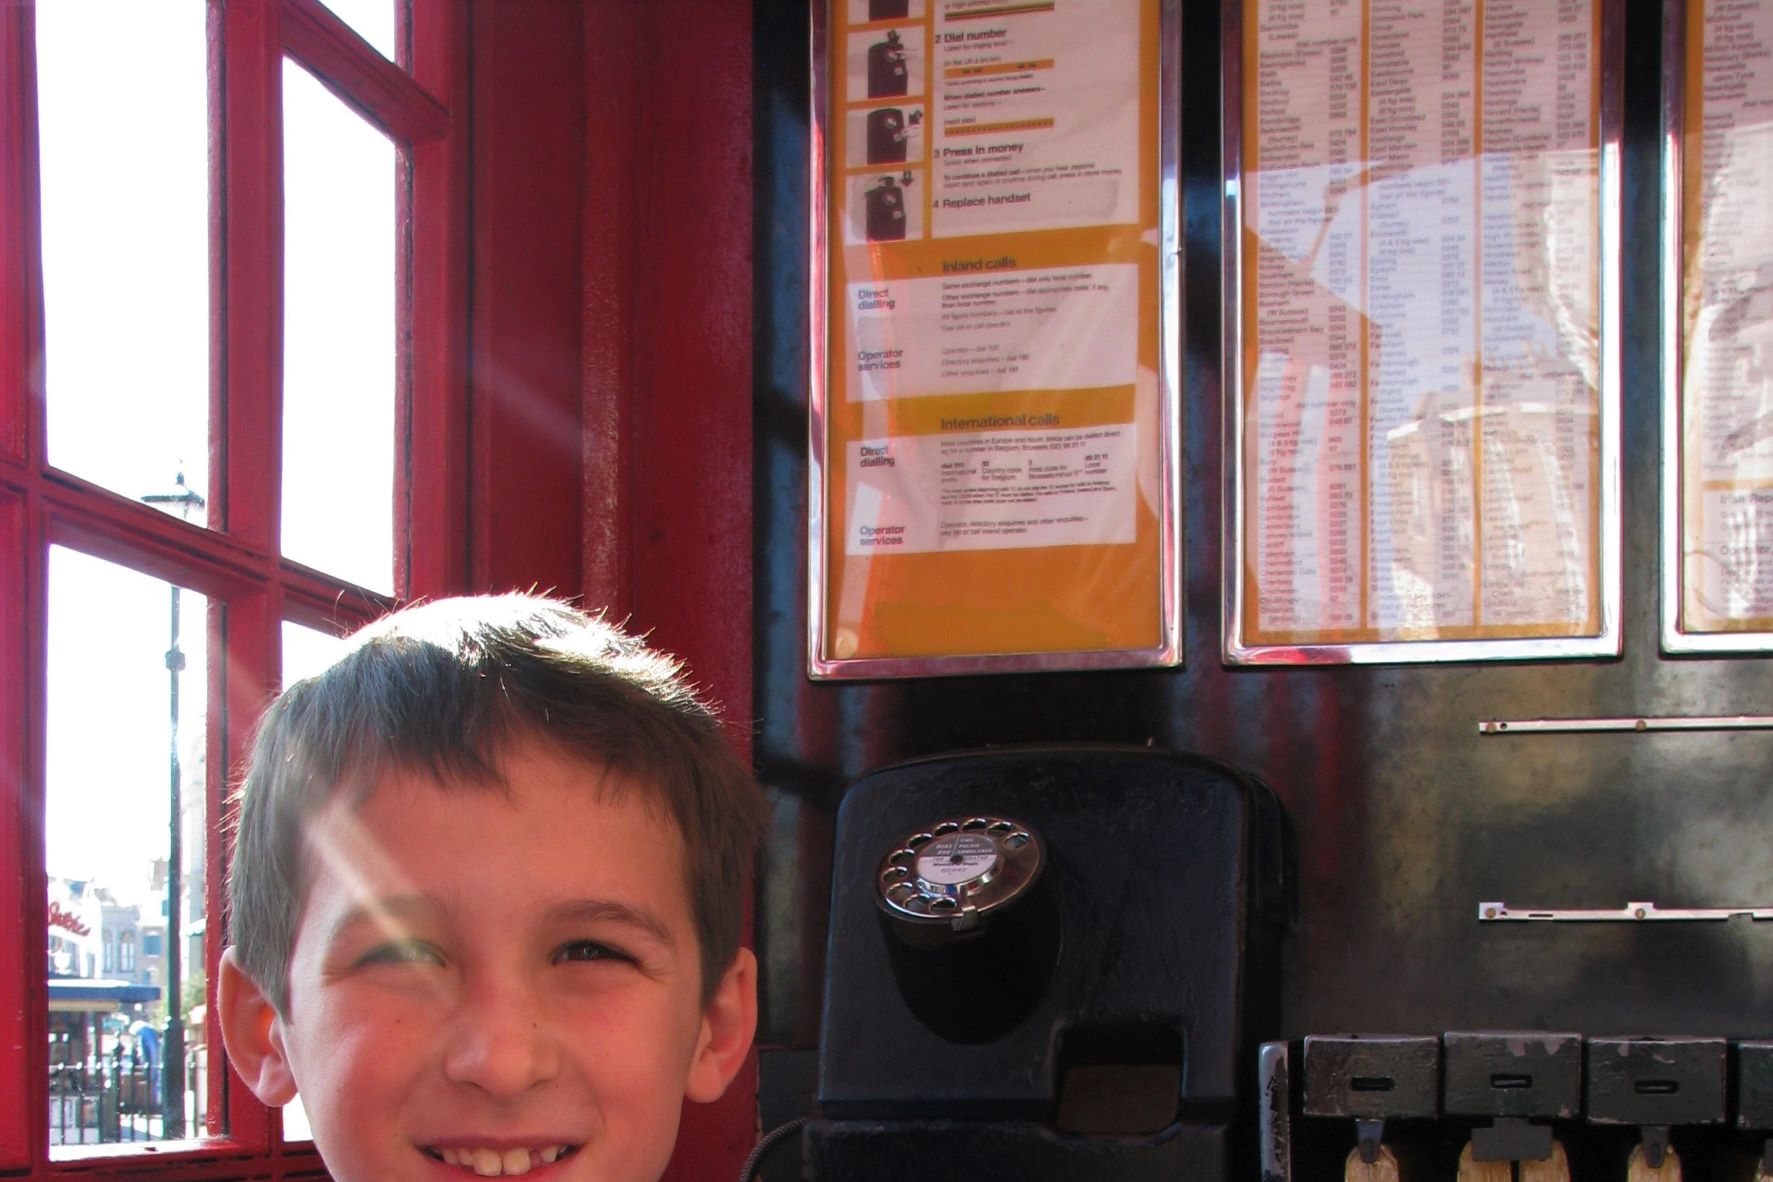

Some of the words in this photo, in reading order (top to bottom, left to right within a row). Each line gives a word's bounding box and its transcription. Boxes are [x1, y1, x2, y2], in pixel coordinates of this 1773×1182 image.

[935, 34, 942, 44] 2
[944, 32, 964, 43] Dial
[967, 29, 1007, 41] number
[934, 148, 941, 158] 3
[943, 147, 973, 157] Press
[976, 145, 985, 154] in
[988, 143, 1024, 154] money
[933, 200, 939, 208] 4
[943, 197, 985, 208] Replace
[988, 193, 1031, 205] handset
[943, 258, 982, 272] Inland
[986, 256, 1017, 270] calls
[858, 288, 889, 299] Direct
[858, 300, 895, 310] dialling
[858, 350, 903, 362] Operator
[858, 360, 901, 371] services
[941, 414, 1026, 430] International
[1028, 413, 1060, 426] calls
[860, 446, 889, 457] Direct
[860, 457, 895, 468] dialling
[860, 525, 905, 537] Operator
[860, 536, 902, 547] services
